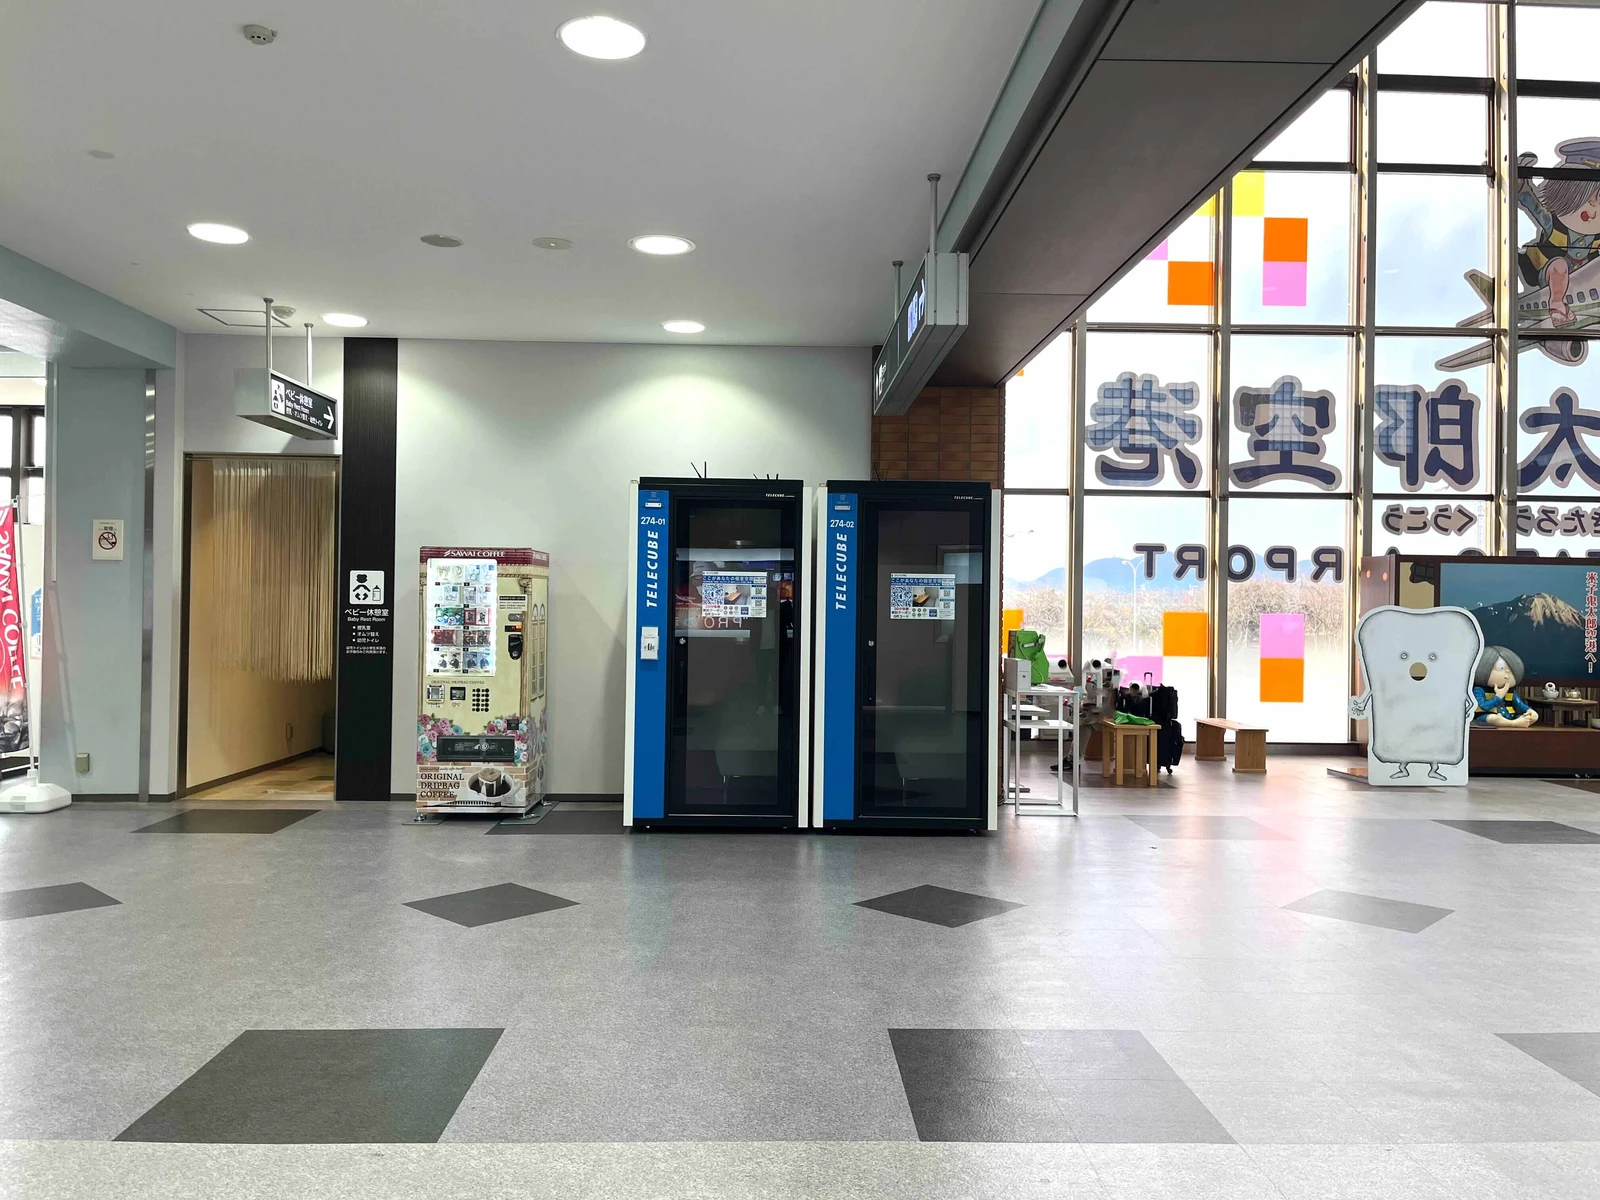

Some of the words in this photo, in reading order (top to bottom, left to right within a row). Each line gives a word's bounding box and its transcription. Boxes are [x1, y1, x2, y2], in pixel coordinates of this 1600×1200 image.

[640, 516, 666, 526] 274-01
[830, 519, 855, 529] 274-02
[646, 530, 659, 608] TELECUBE
[835, 532, 847, 610] TELECUBE
[344, 608, 389, 617] ベビー休憩室
[420, 773, 465, 781] ORIGINAL
[420, 781, 460, 790] DRIPBAG
[420, 791, 455, 799] COFFEE
